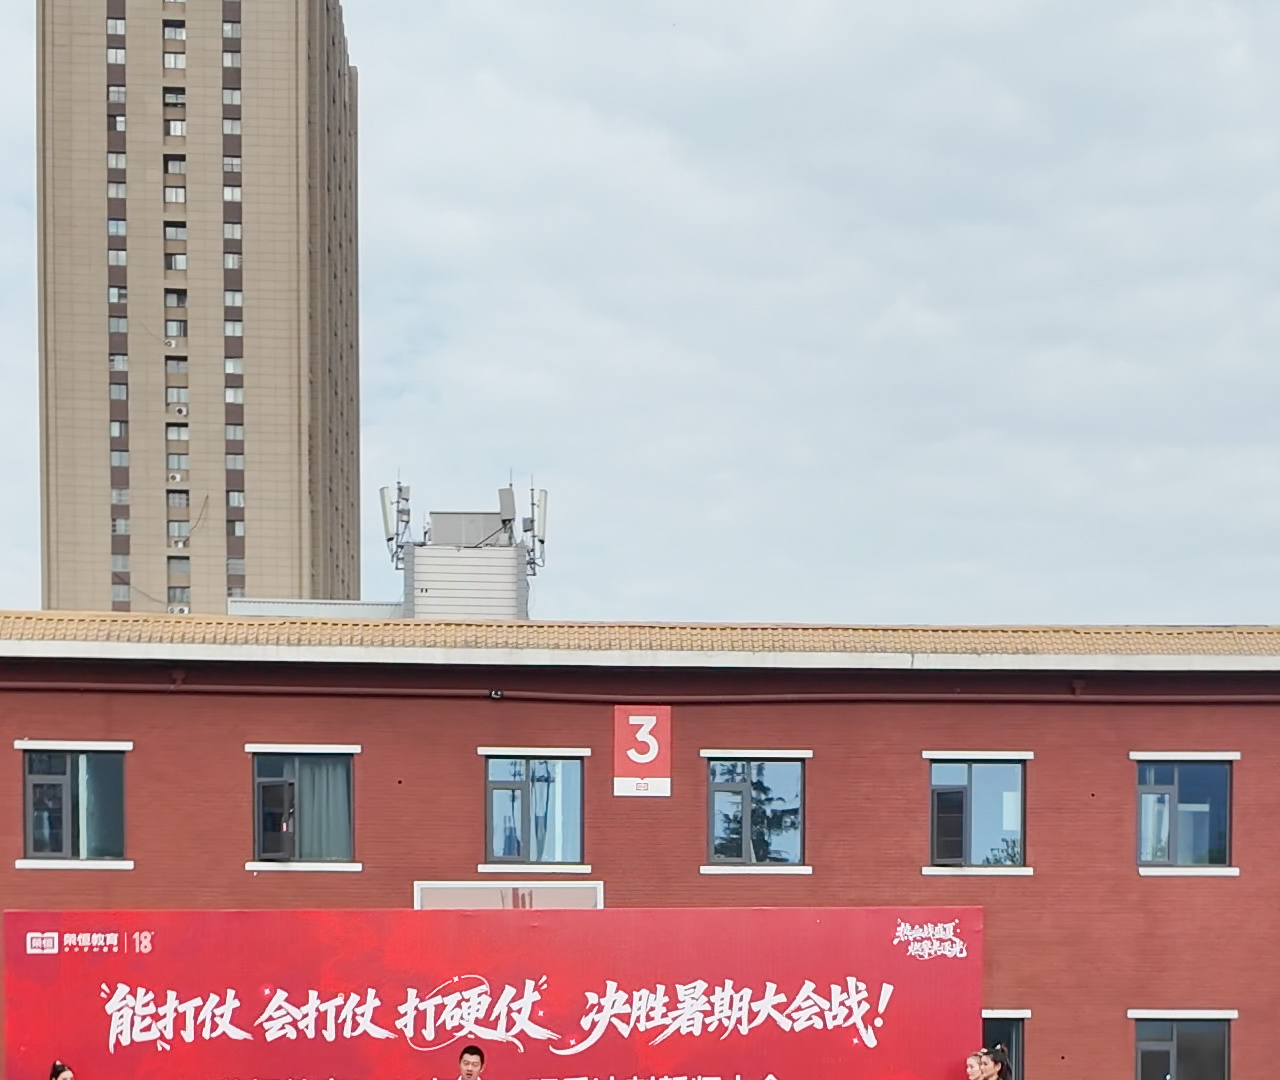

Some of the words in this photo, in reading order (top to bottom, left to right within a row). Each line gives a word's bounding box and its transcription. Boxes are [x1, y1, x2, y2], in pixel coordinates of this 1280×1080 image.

[626, 715, 659, 764] 3
[63, 932, 119, 947] 荣恒教育
[104, 983, 254, 1054] 能打仗
[254, 986, 399, 1042] 会打仗
[394, 979, 562, 1050] 打硬仗
